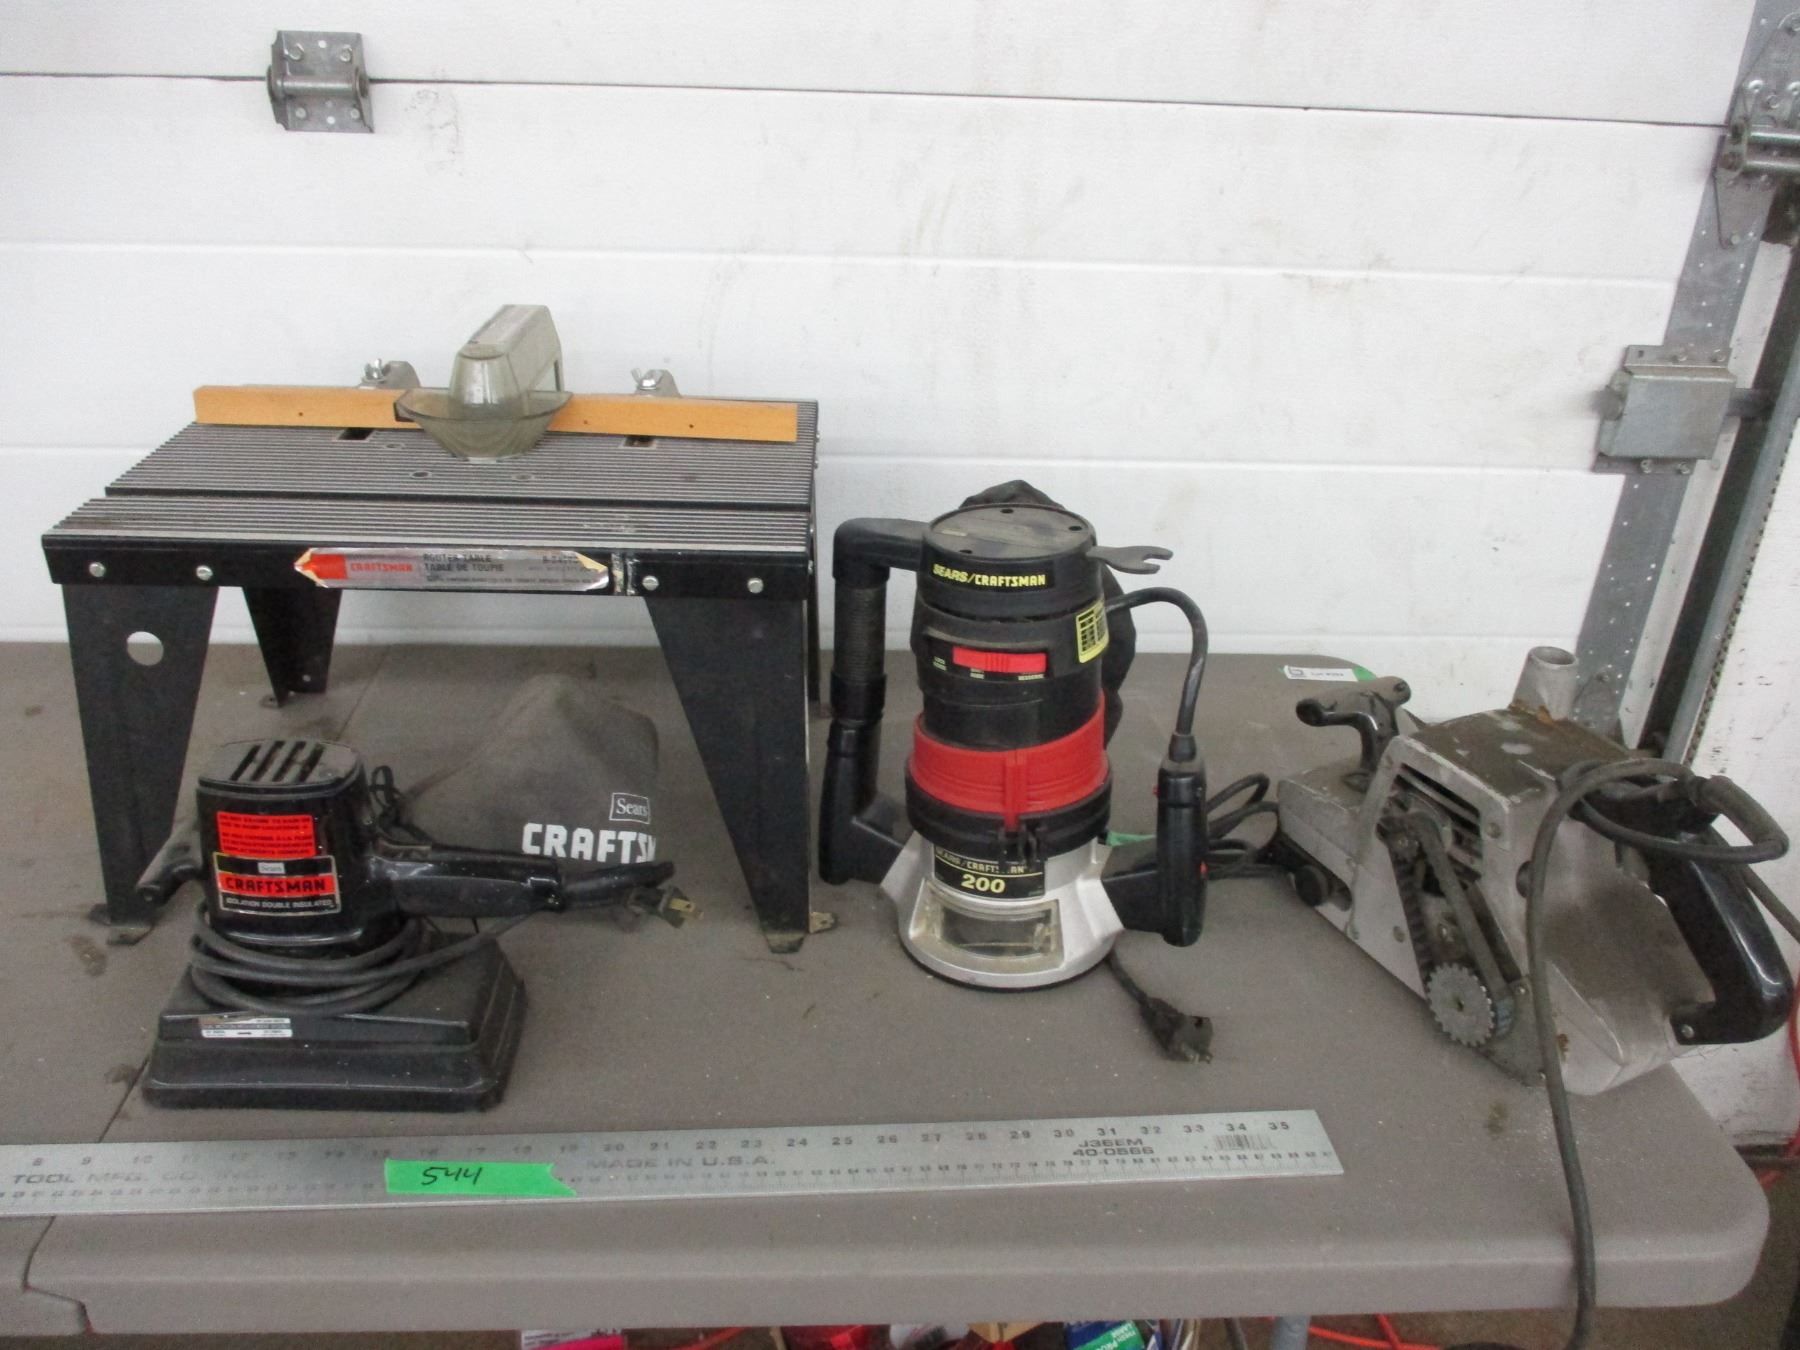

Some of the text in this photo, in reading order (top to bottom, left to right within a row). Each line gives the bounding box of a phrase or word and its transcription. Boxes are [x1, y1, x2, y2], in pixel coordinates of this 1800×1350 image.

[351, 563, 413, 573] CRAFTSMAN
[932, 563, 1046, 588] SEARS/CRAFTSMAN
[616, 798, 648, 816] Sears
[225, 877, 326, 893] CRAFTSMAN
[961, 873, 1006, 894] 200
[81, 1156, 92, 1166] 9
[650, 1141, 669, 1151] 21
[741, 1139, 763, 1149] 23
[787, 1137, 808, 1147] 24
[832, 1136, 853, 1146] 25
[877, 1134, 898, 1144] 26
[921, 1133, 942, 1143] 27
[1010, 1129, 1031, 1139] 29
[1054, 1129, 1075, 1138] 30
[1097, 1127, 1117, 1137] 31
[1140, 1125, 1161, 1135] 32
[1183, 1124, 1205, 1134] 33
[1227, 1123, 1247, 1132] 34
[1268, 1121, 1290, 1131] 35
[1079, 1138, 1144, 1148] J36EM
[587, 1158, 658, 1169] MADE
[667, 1157, 692, 1167] IN
[13, 1174, 75, 1185] TOOL
[421, 1166, 484, 1187] 544
